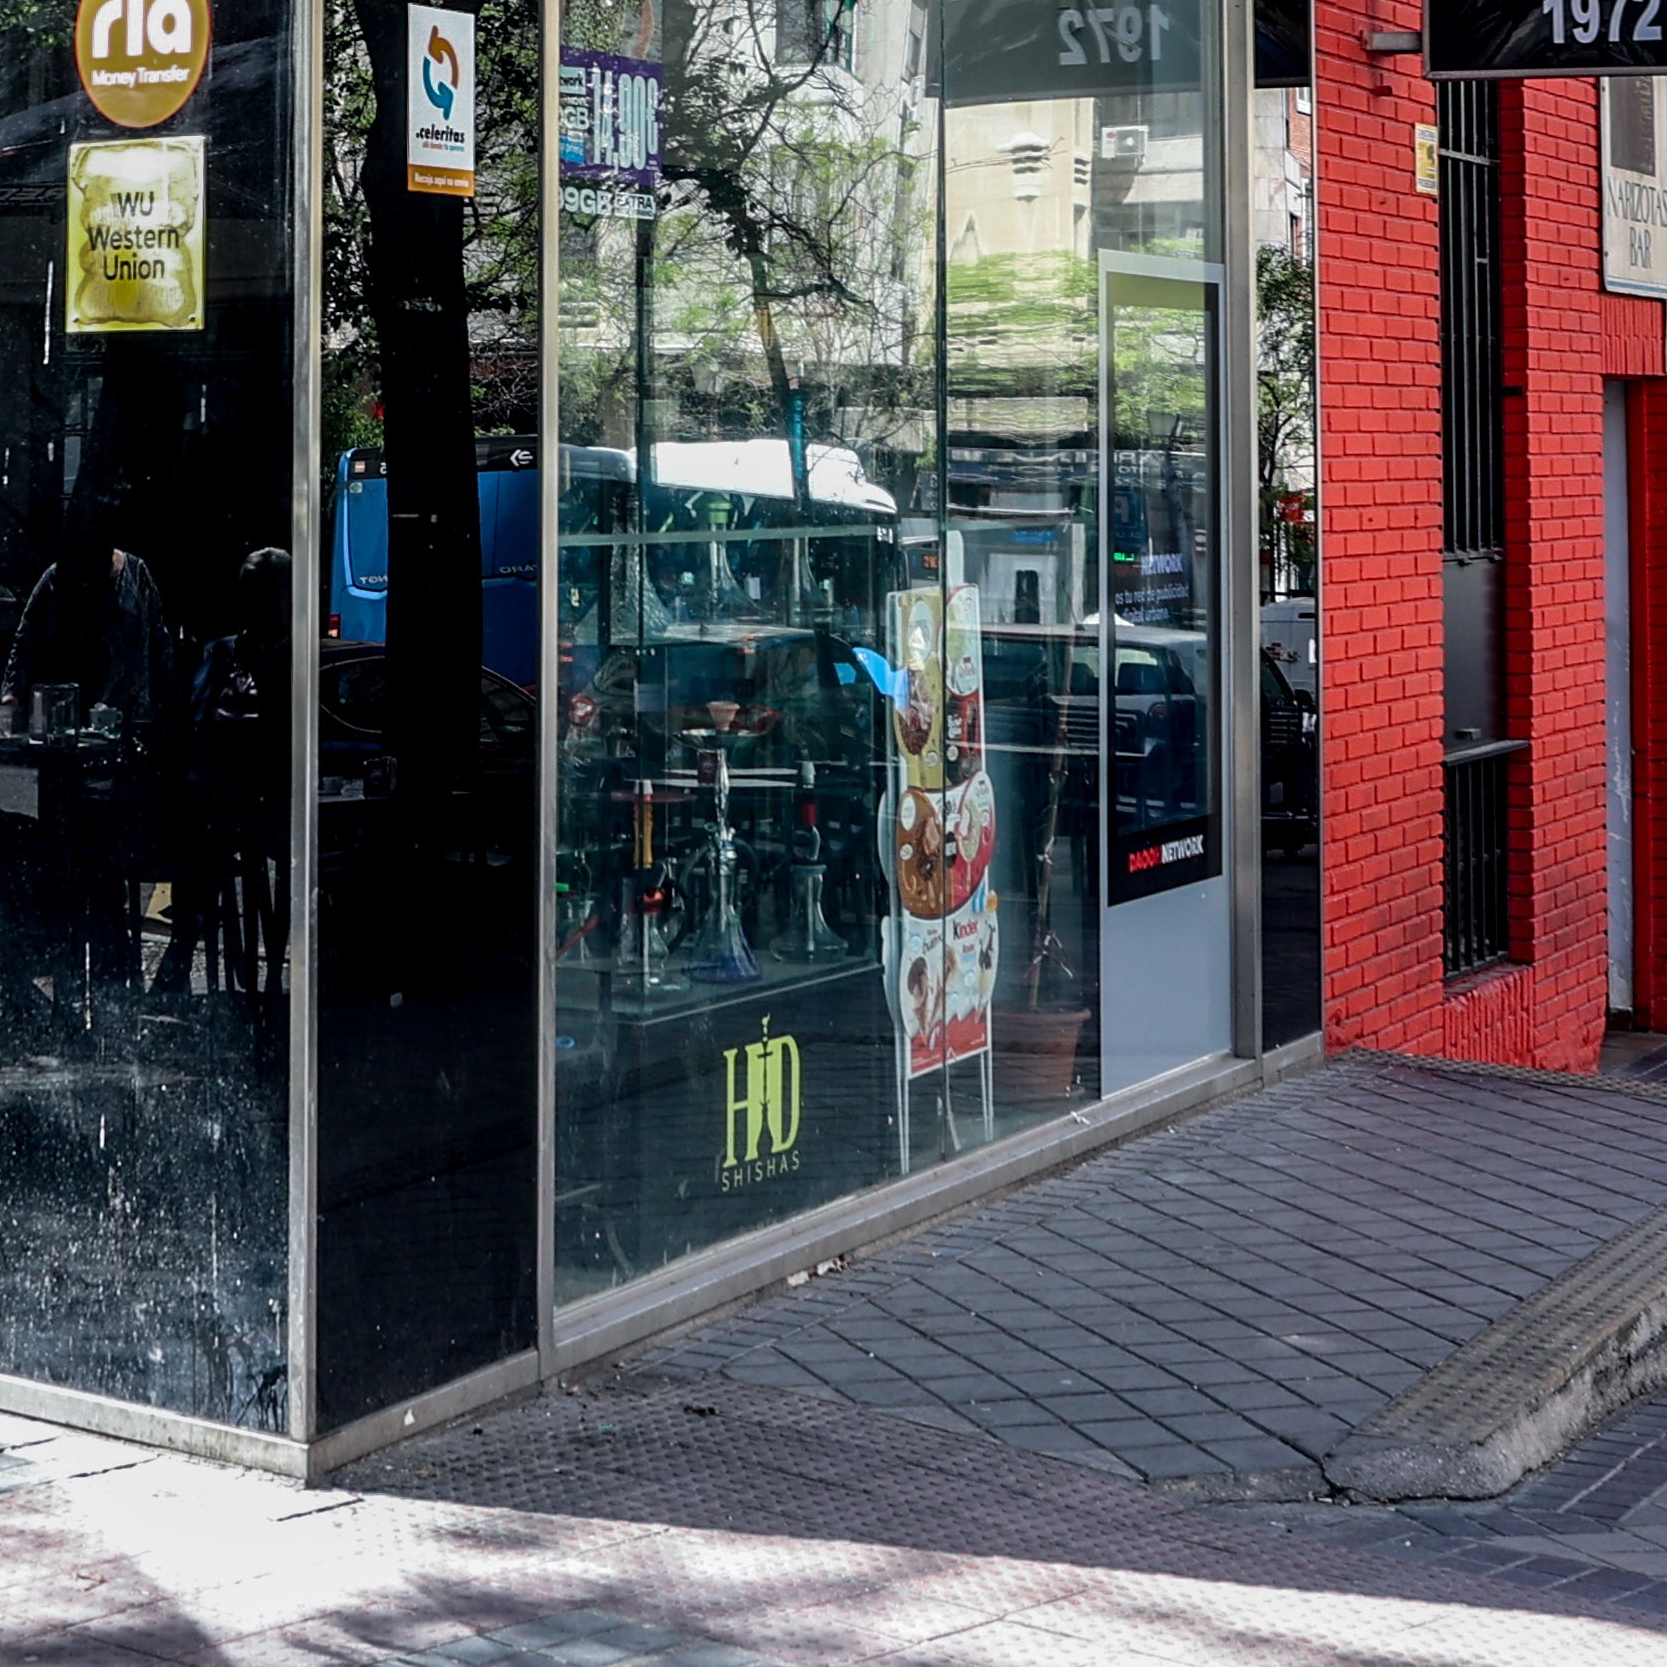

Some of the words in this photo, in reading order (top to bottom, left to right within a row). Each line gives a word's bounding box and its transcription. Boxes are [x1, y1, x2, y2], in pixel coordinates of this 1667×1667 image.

[91, 69, 137, 88] Money
[136, 64, 191, 84] Transfer
[111, 191, 154, 217] WU
[87, 223, 179, 251] Western
[1629, 227, 1652, 270] BAR
[104, 252, 165, 281] Union
[1161, 834, 1204, 865] NETWORK
[721, 1149, 800, 1193] SHISHAS
